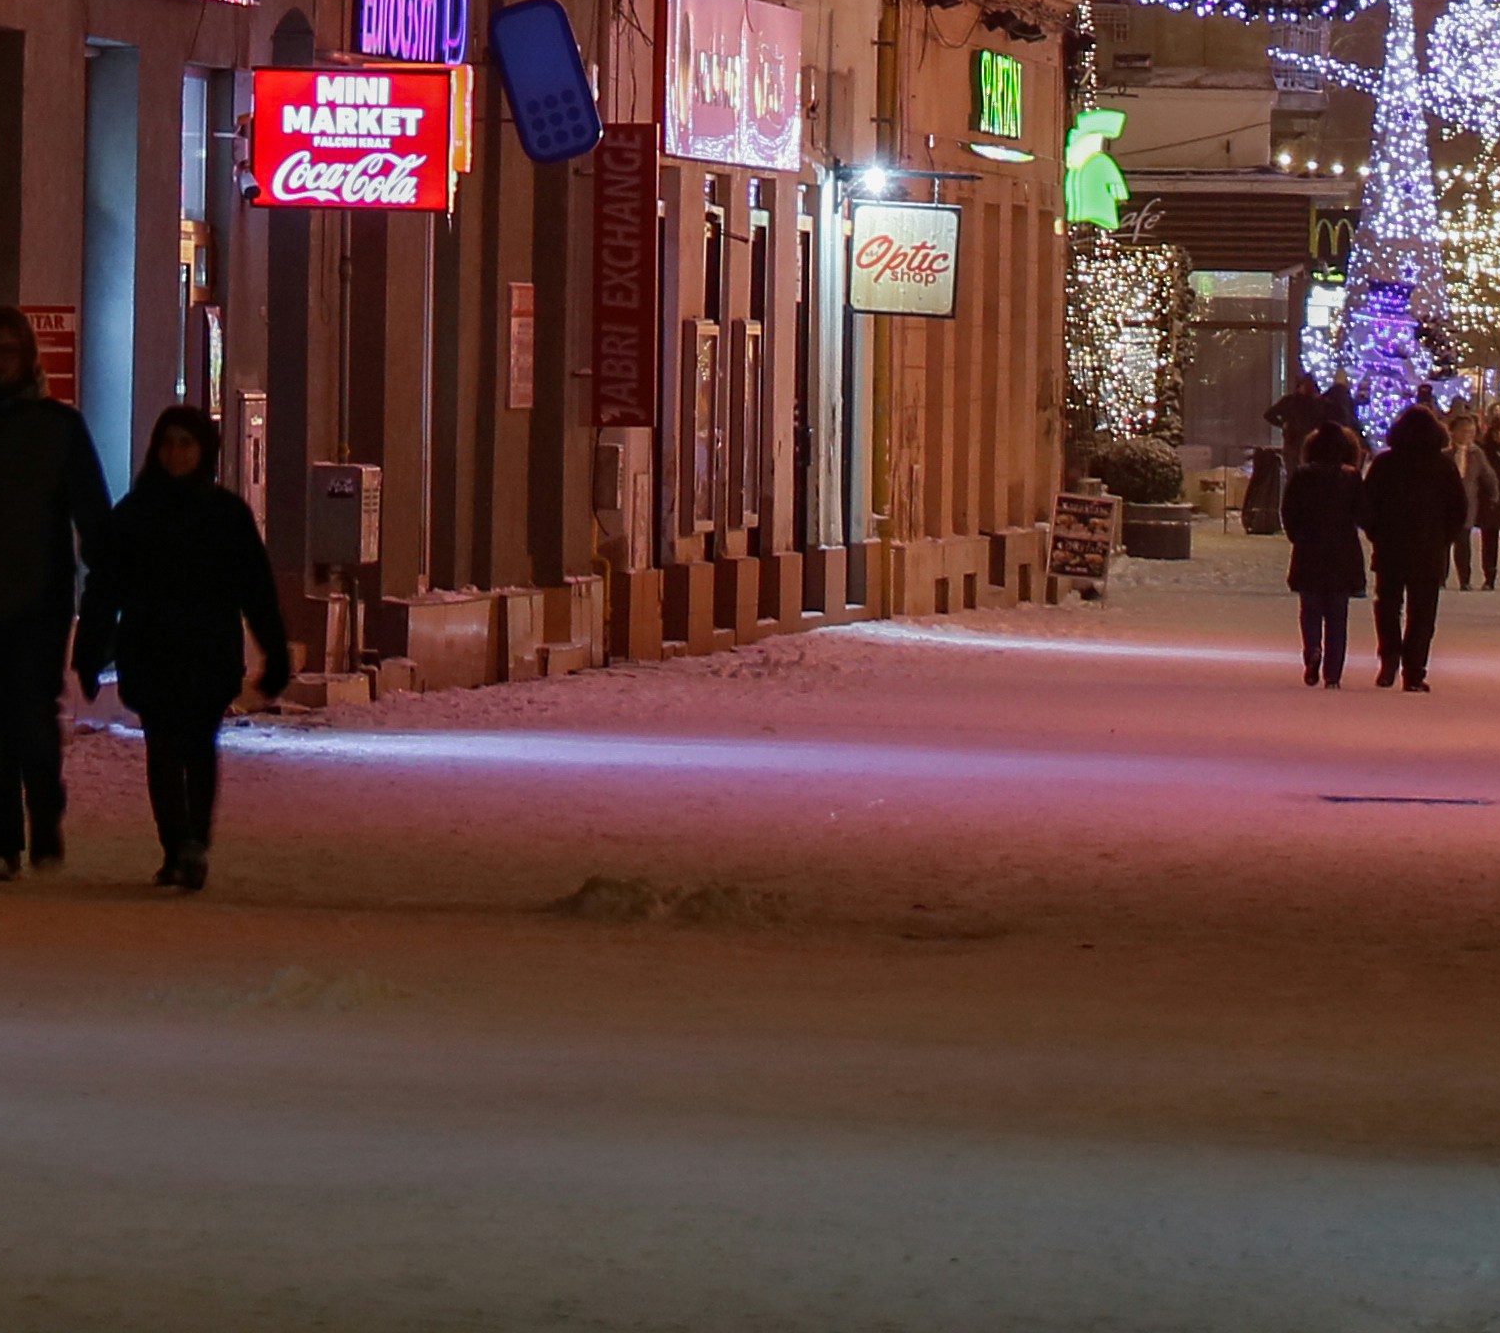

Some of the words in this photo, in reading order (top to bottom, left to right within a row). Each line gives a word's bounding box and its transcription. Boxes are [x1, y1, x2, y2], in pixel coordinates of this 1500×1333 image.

[315, 75, 390, 106] MINI
[281, 105, 424, 137] MARKET
[312, 136, 358, 148] FALCON
[358, 136, 391, 150] KRAX
[271, 150, 428, 204] Coca-Cola
[600, 128, 643, 310] EXCHANGE
[1119, 196, 1167, 245] afé
[856, 235, 950, 284] Optic
[890, 268, 937, 287] shop
